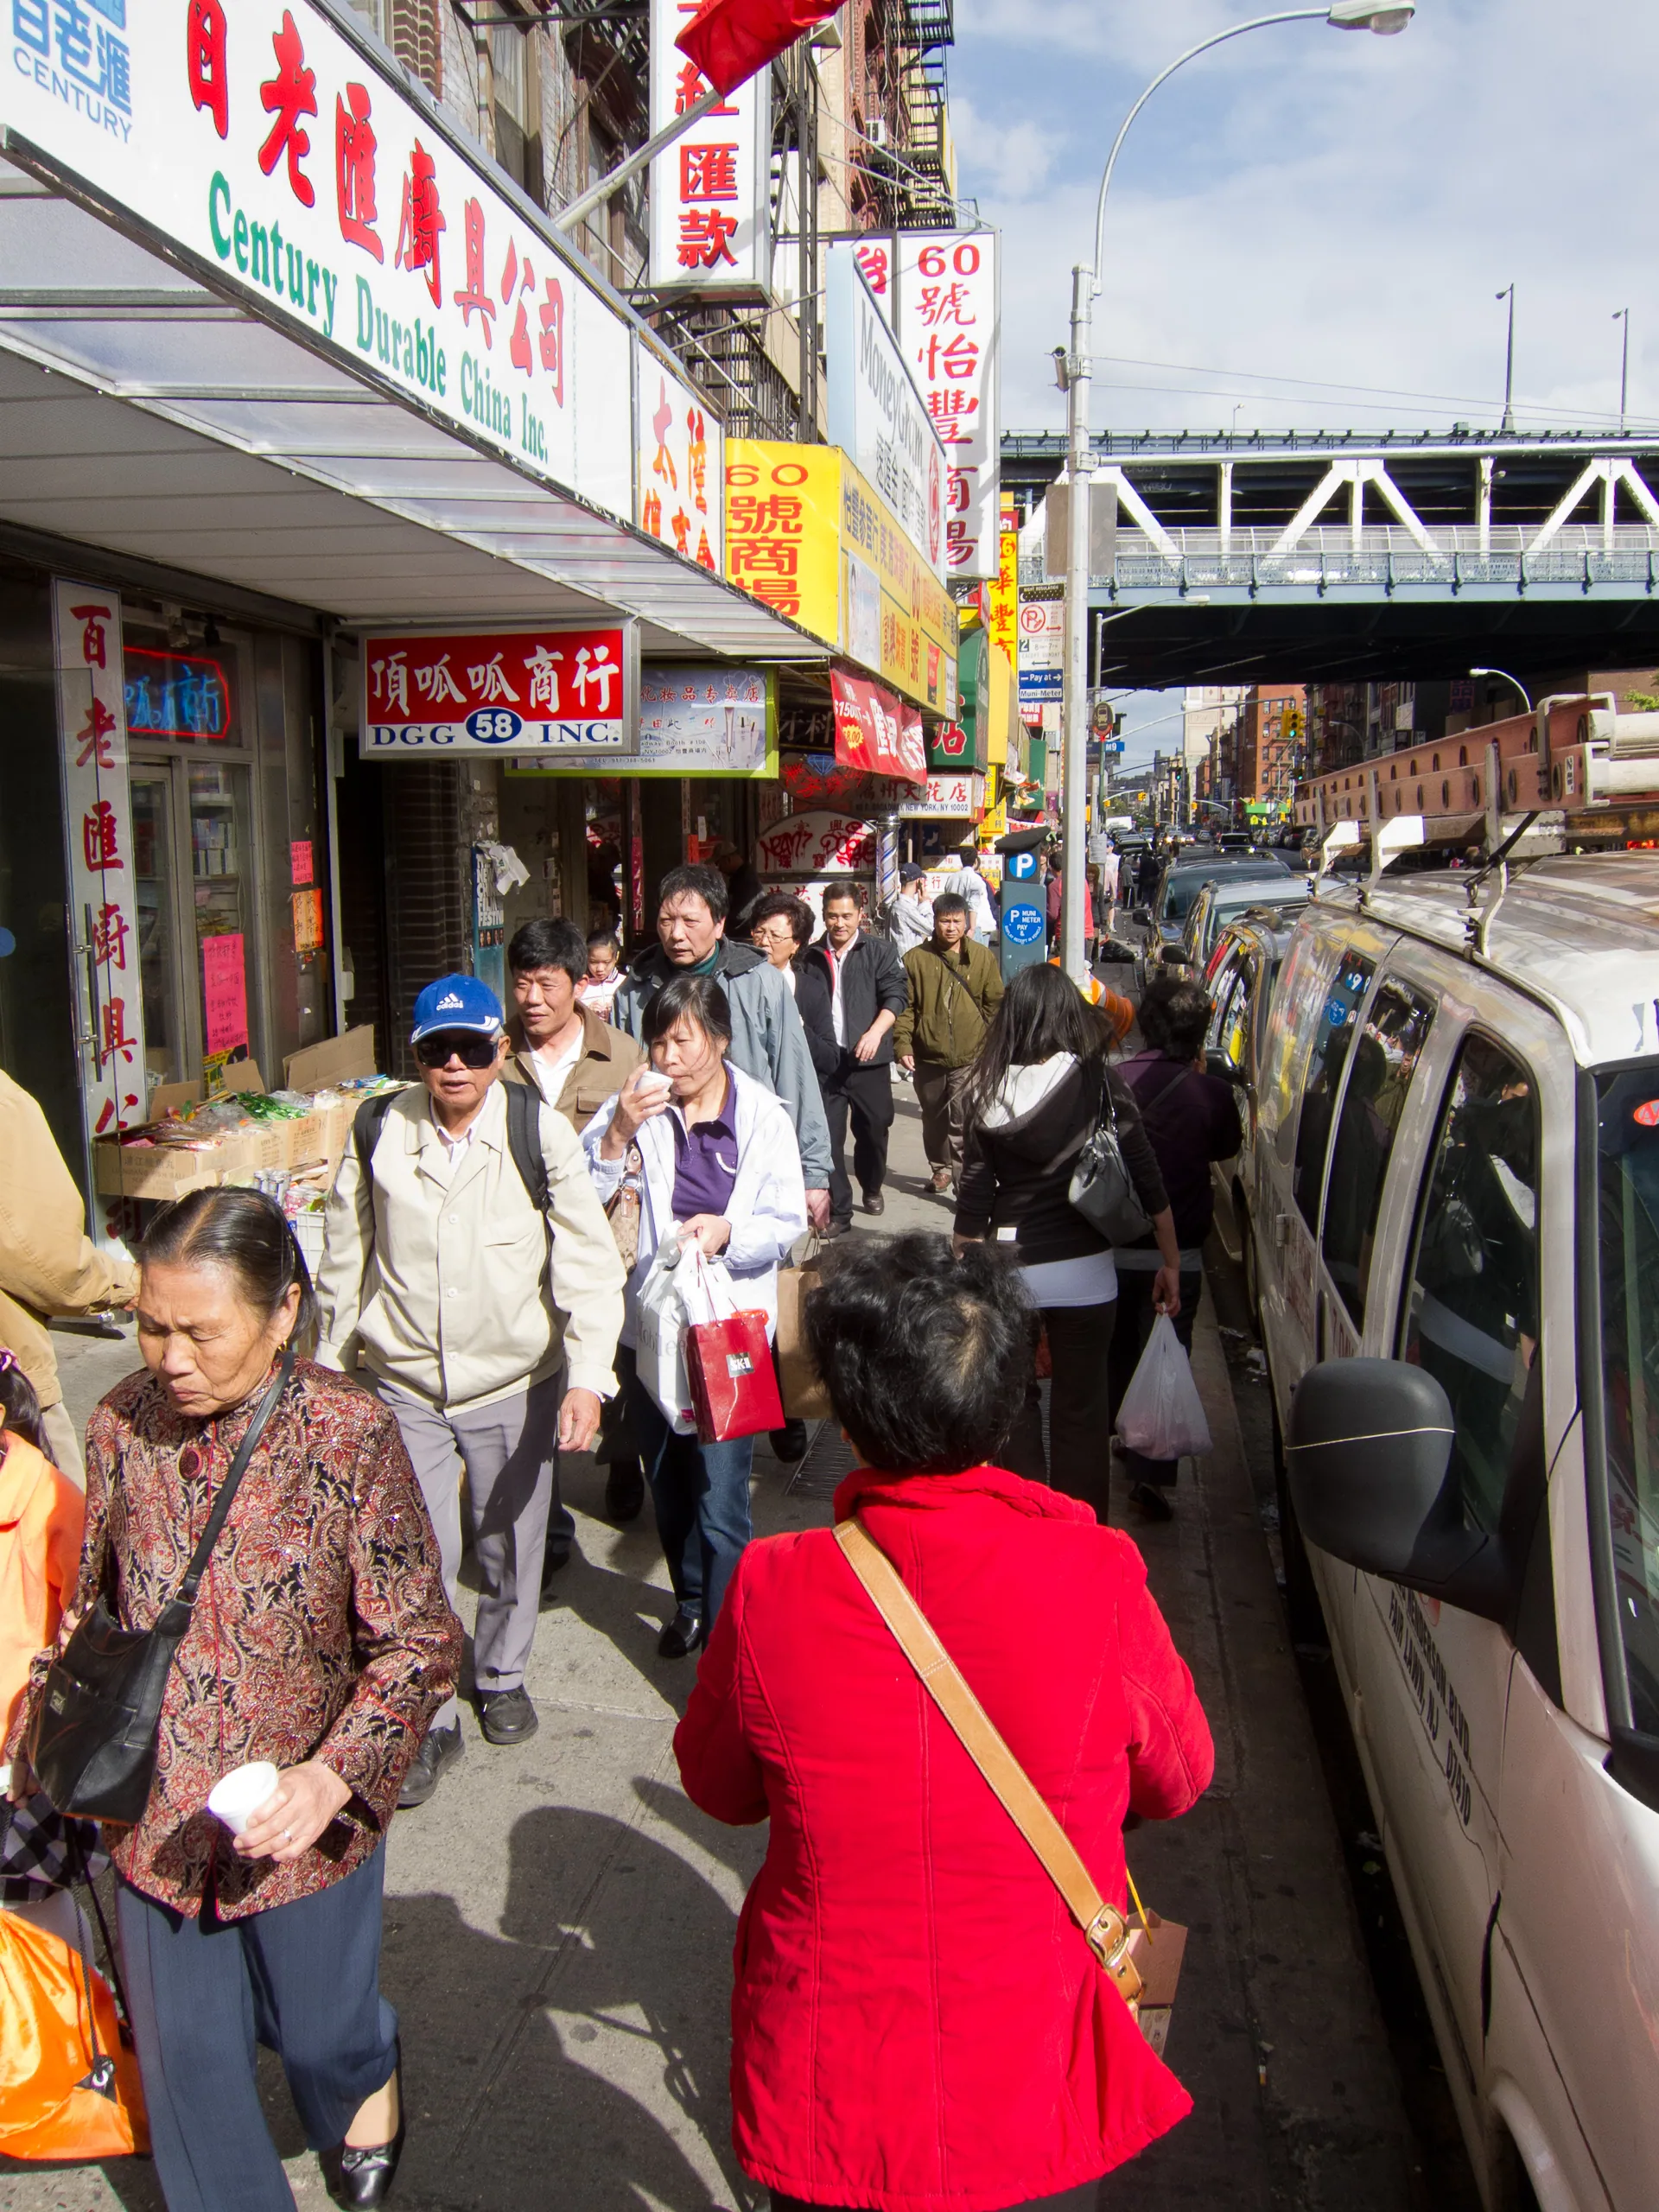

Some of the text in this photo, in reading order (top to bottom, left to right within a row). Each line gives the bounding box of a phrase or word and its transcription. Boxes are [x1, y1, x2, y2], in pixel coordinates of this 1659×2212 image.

[14, 47, 132, 143] CENTURY
[208, 170, 549, 464] Century Durable China Inc.
[860, 296, 924, 469] MoneyGram
[1029, 674, 1043, 683] Pay
[372, 713, 620, 746] DGG 58 INC.
[921, 804, 939, 812] YORK,
[1016, 853, 1033, 878] P
[1010, 909, 1020, 923] P
[436, 1000, 464, 1011] adidas
[1389, 1587, 1404, 1648] FAIR
[1403, 1627, 1426, 1715] LAWN,
[1427, 1688, 1440, 1742] NJ
[1446, 1738, 1471, 1827] 07410
